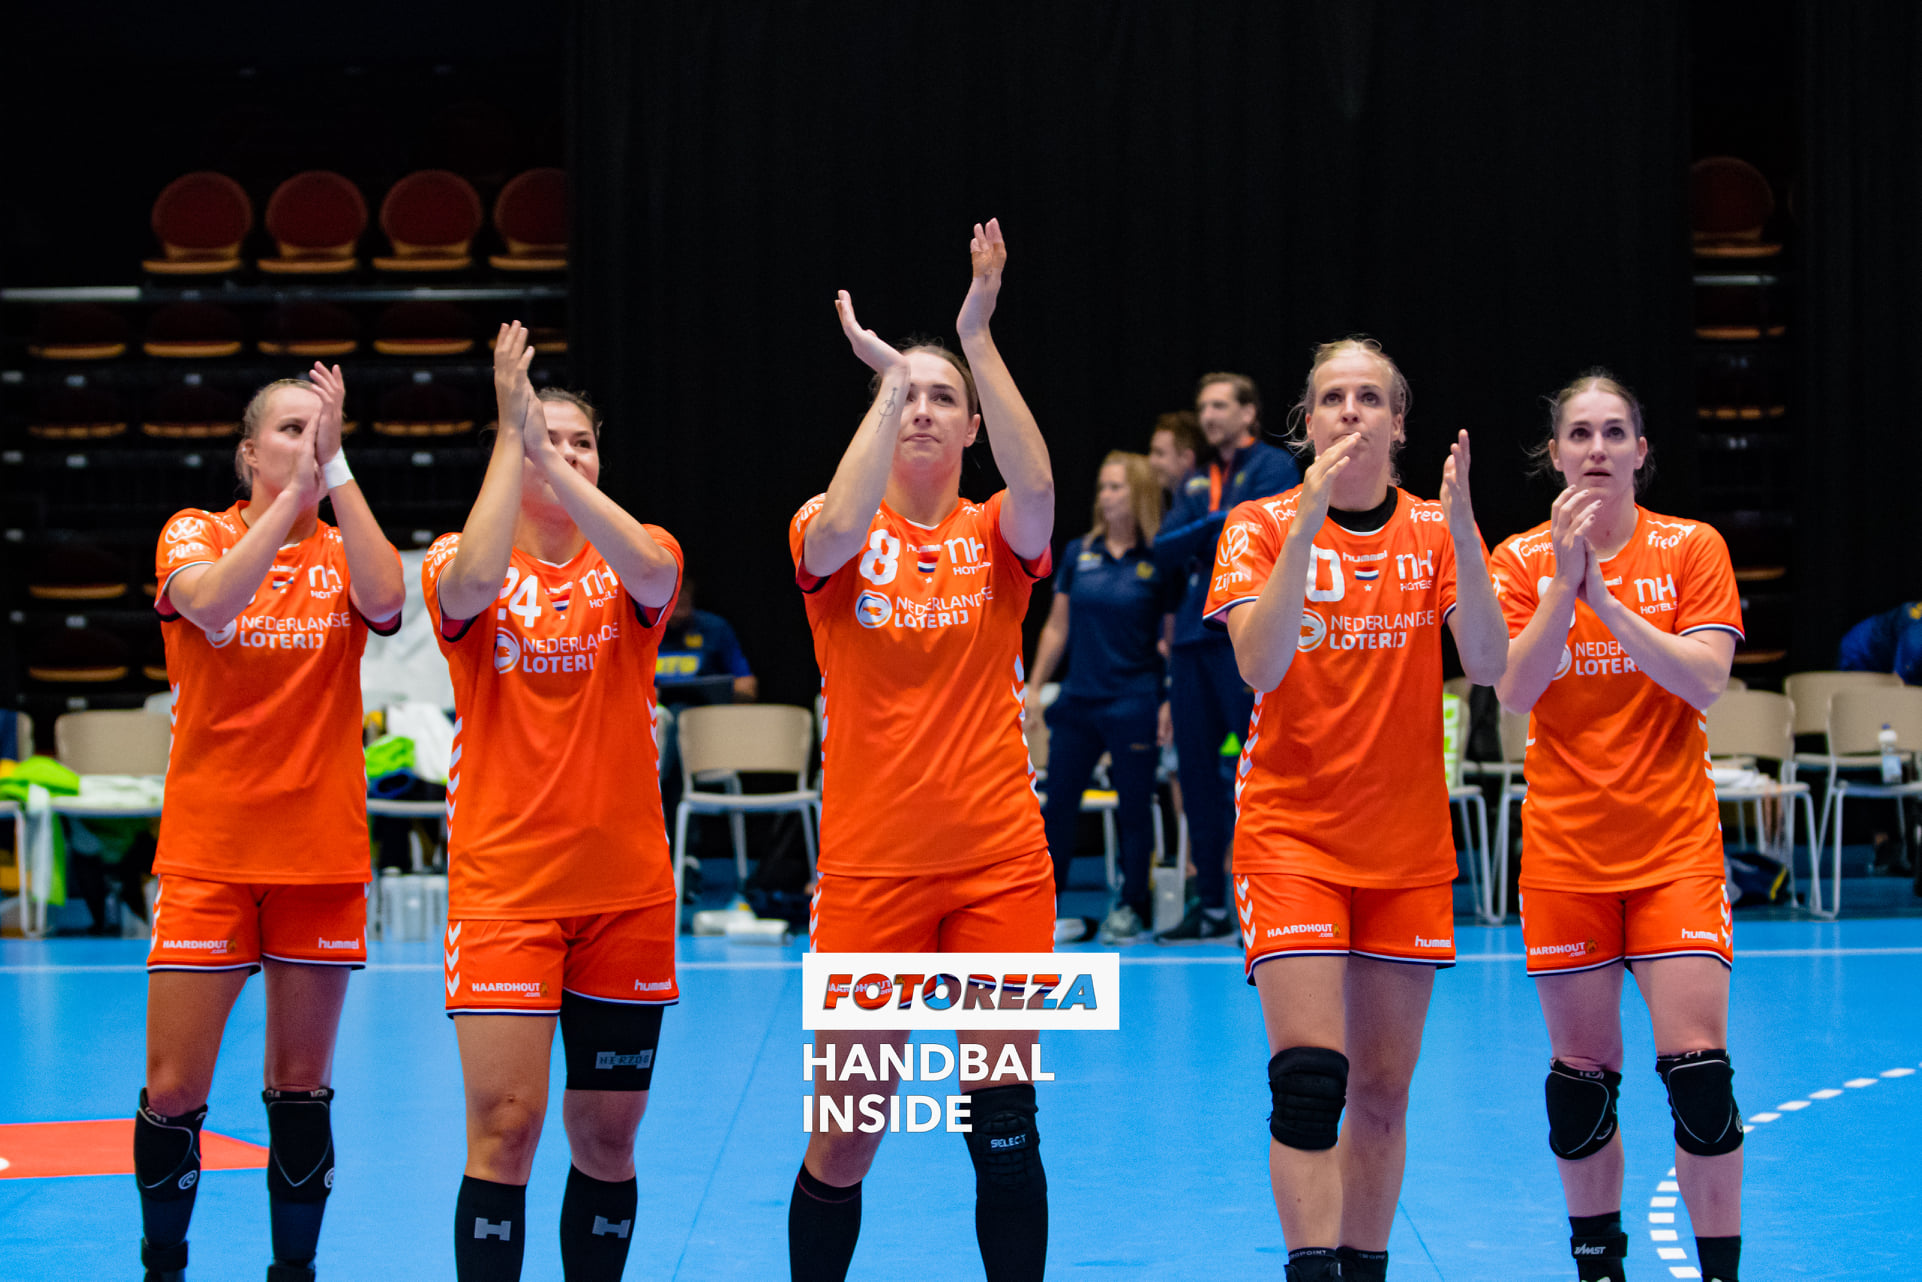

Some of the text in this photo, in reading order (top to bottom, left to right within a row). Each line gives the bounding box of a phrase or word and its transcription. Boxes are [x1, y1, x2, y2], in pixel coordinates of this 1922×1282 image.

[859, 529, 900, 586] 8
[1343, 550, 1388, 562] hummel
[894, 610, 969, 629] LOTERIJ
[240, 630, 324, 649] LOTERIJ
[1329, 632, 1407, 650] LOTERIJ
[1575, 641, 1627, 657] NEDER
[523, 653, 598, 674] LOTERI
[1575, 657, 1640, 676] LOTER
[1267, 923, 1333, 938] HAARDHOUT
[318, 937, 359, 949] hummel
[472, 982, 540, 992] HAARDHOUT
[990, 1134, 1026, 1149] SELECT
